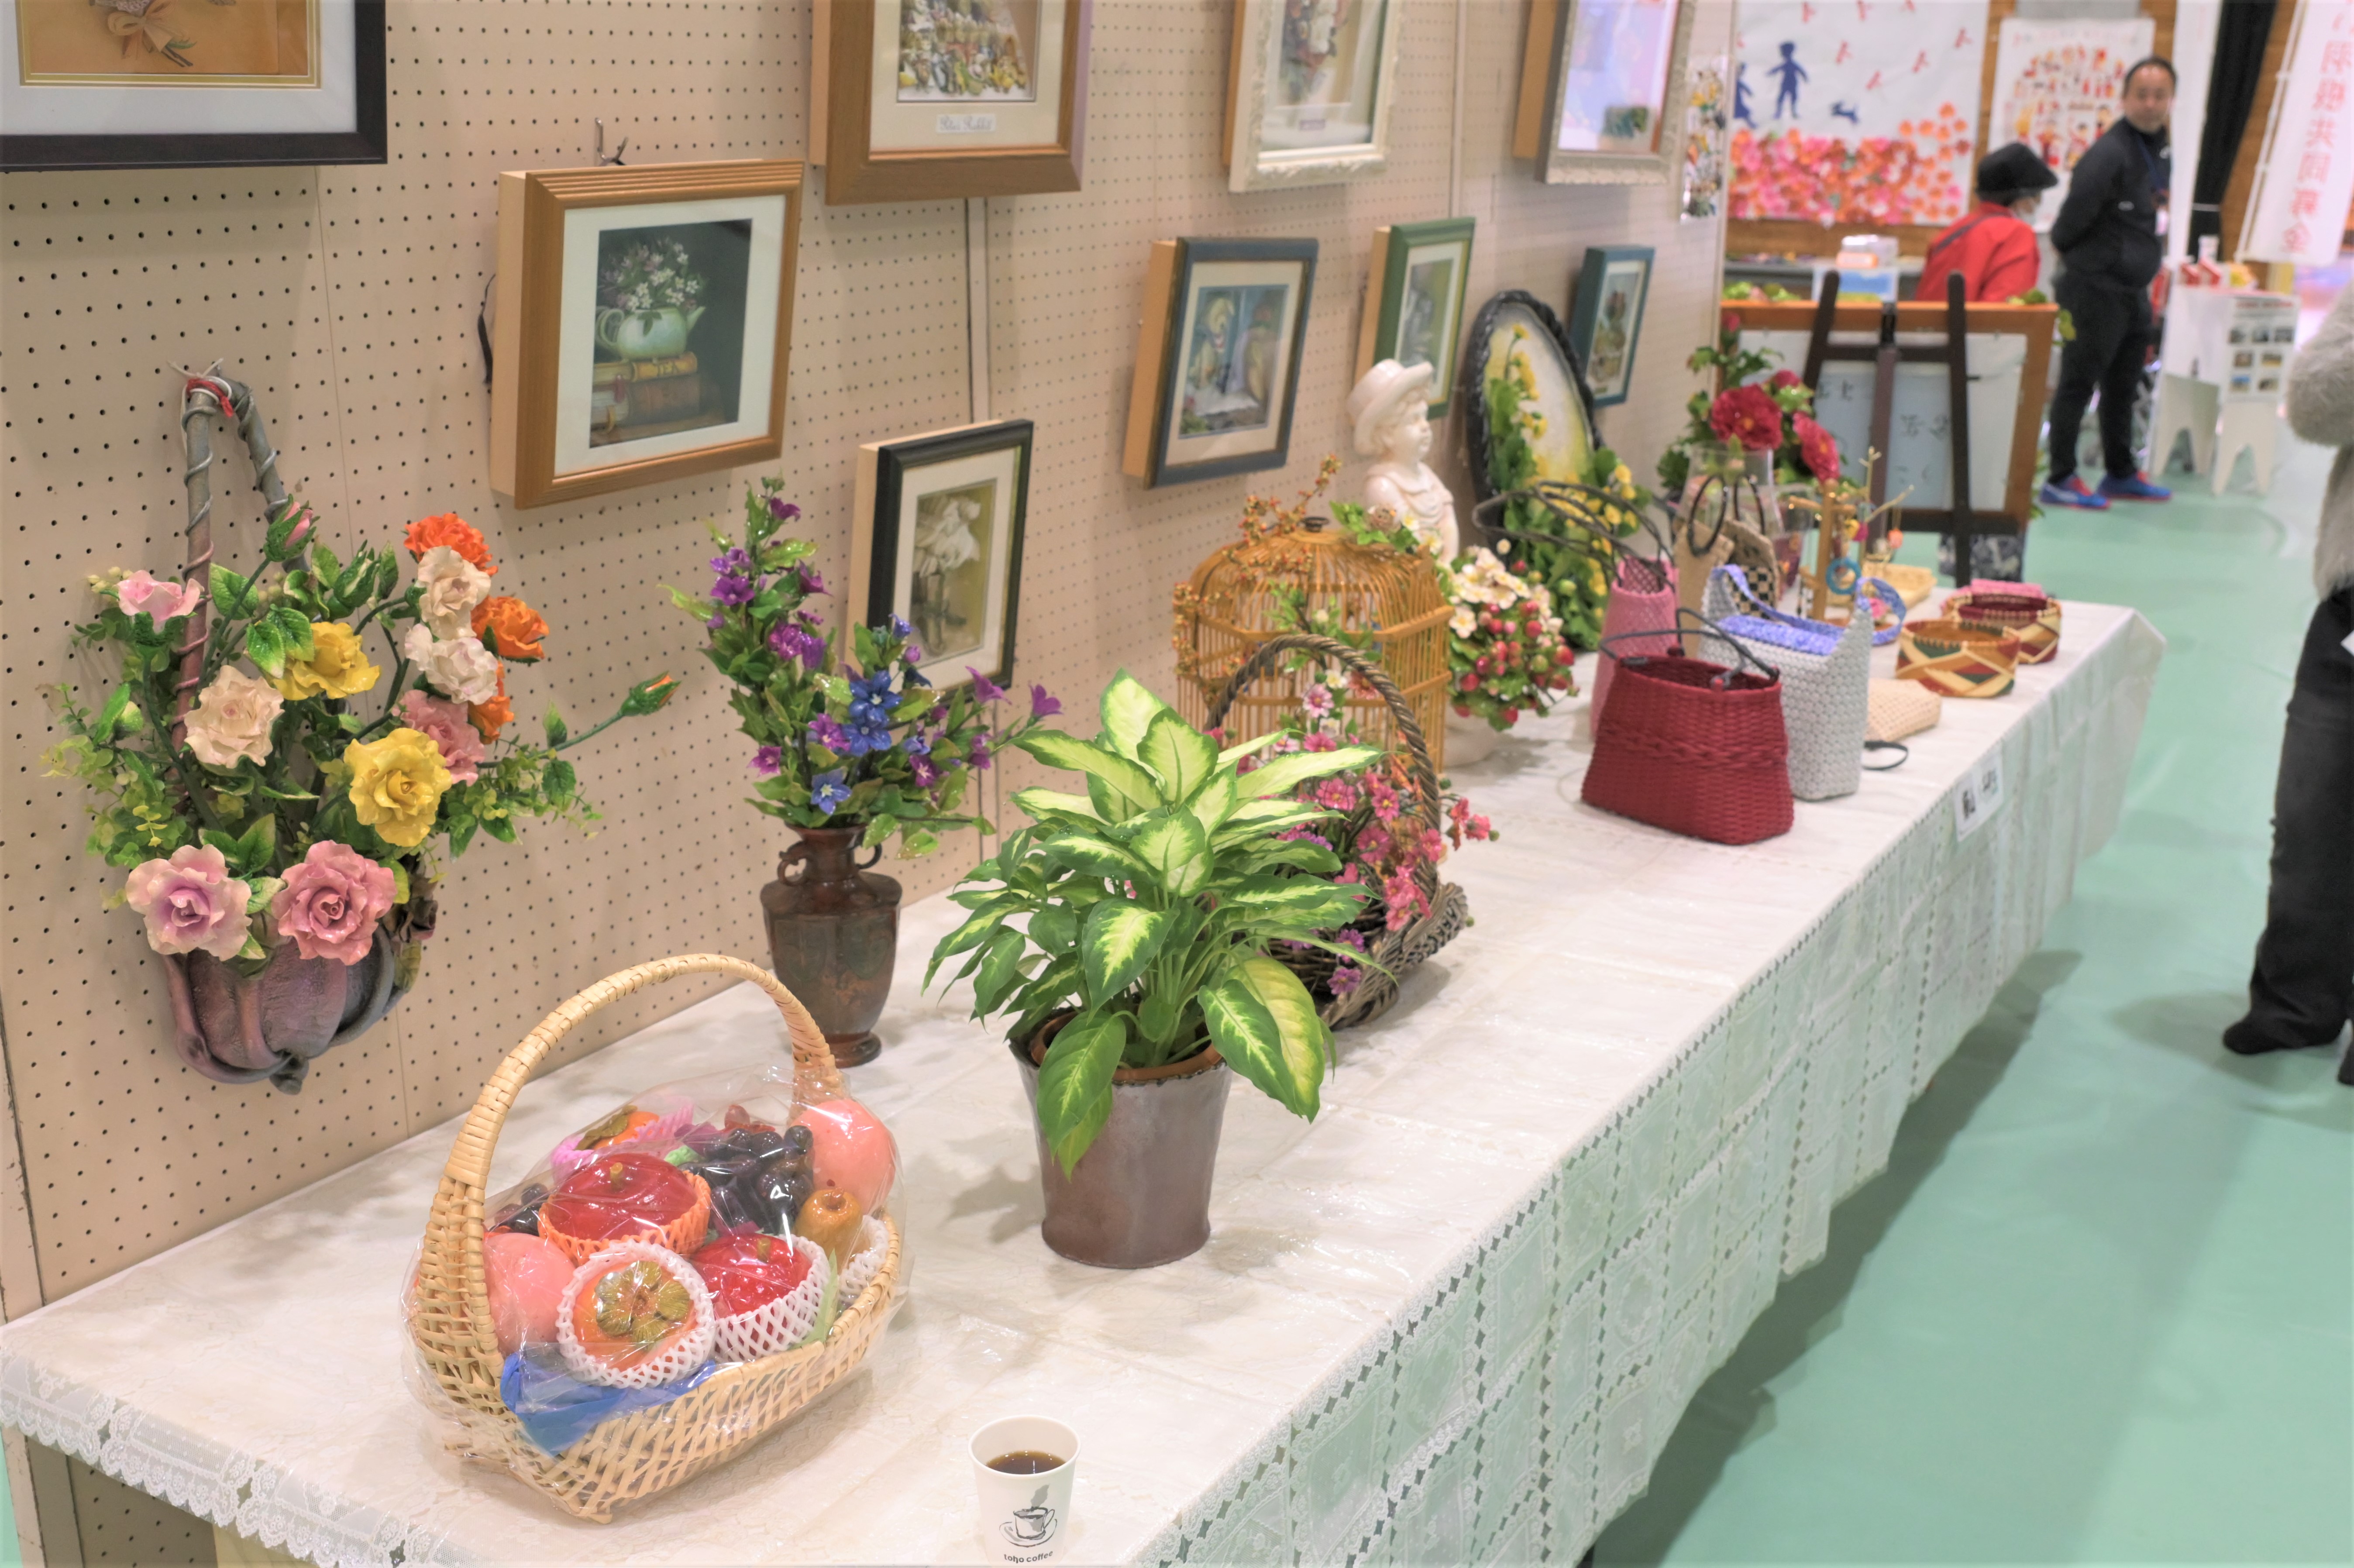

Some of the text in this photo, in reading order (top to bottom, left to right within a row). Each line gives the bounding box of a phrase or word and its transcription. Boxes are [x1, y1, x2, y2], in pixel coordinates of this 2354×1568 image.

[2281, 0, 2354, 254] い羽根共同募金
[1004, 1551, 1053, 1564] toho coffee
